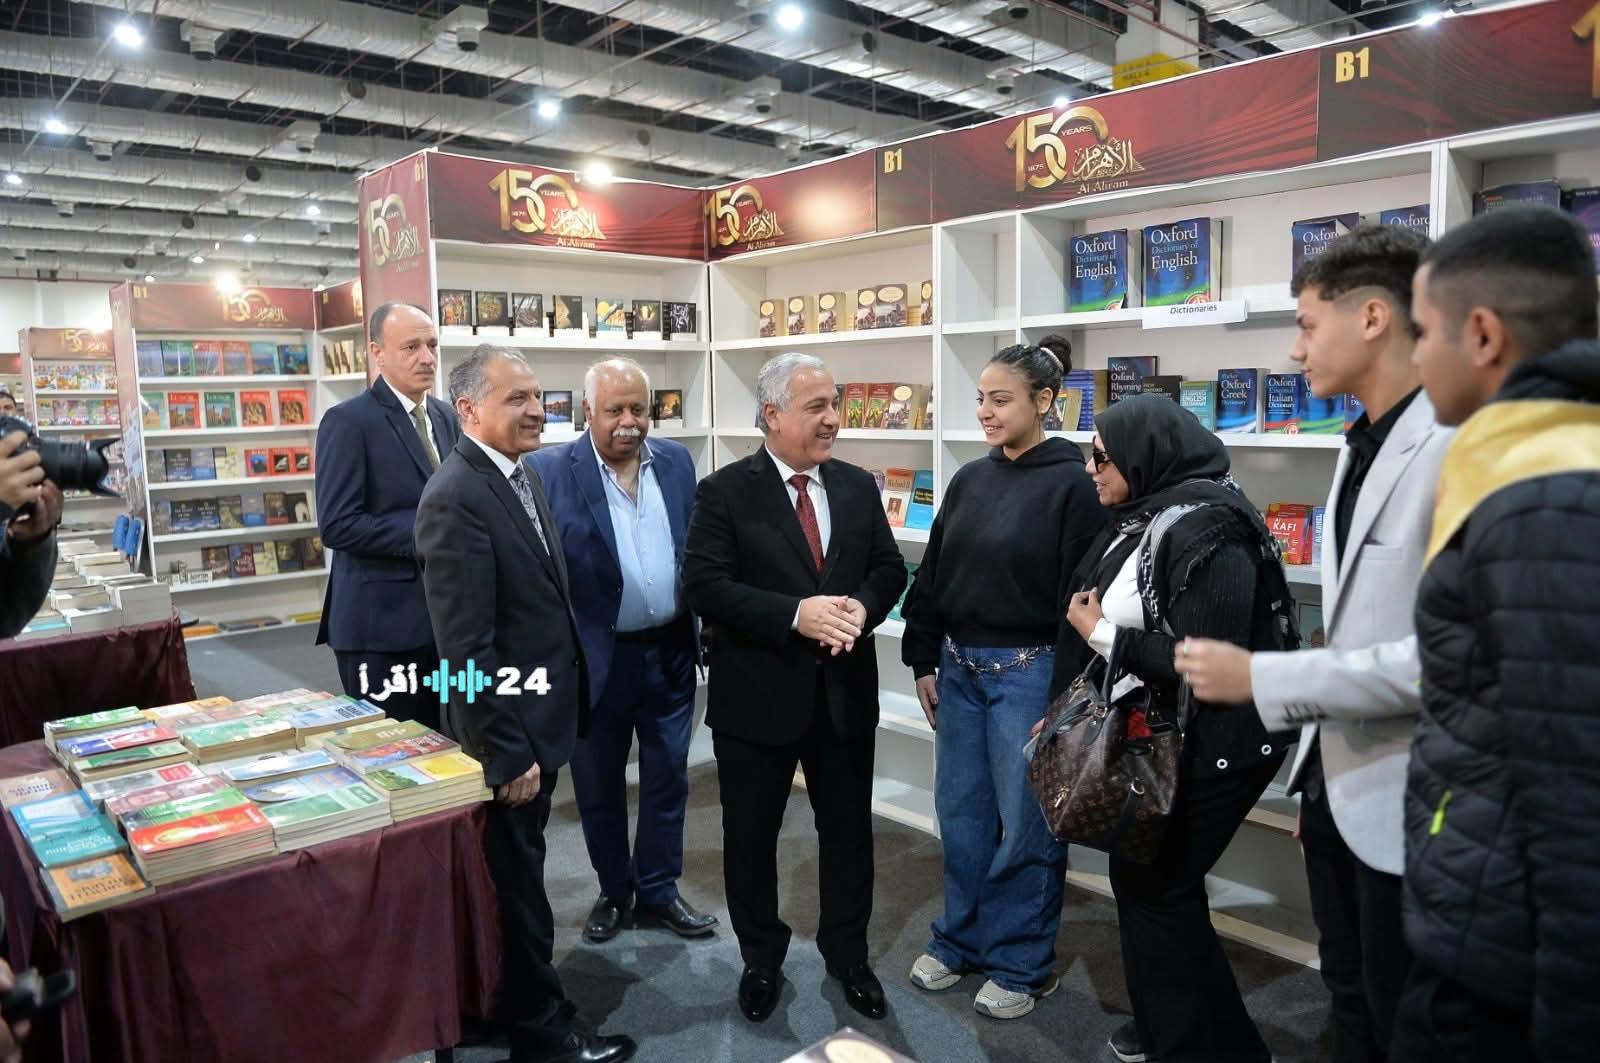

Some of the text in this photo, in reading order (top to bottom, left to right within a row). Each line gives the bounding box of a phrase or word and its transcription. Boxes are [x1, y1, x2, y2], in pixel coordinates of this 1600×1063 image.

[1336, 47, 1370, 83] B1
[1061, 124, 1093, 137] YEARS
[1005, 106, 1109, 191] 150
[884, 147, 902, 174] B1
[488, 168, 577, 233] 150
[705, 184, 763, 248] 150
[1150, 223, 1198, 245] Oxford
[1075, 234, 1116, 254] Oxford
[1151, 241, 1198, 255] Dictionary of
[1076, 252, 1116, 264] Dictionary of
[1151, 251, 1198, 272] English
[1075, 261, 1117, 280] English
[1170, 304, 1217, 315] Dictionaries
[1111, 363, 1128, 372] New
[1111, 373, 1137, 381] Oxford
[1268, 376, 1296, 387] Oxford
[1111, 383, 1142, 393] Rhyming
[1221, 379, 1251, 389] Oxford
[1221, 389, 1248, 399] Greek
[1268, 393, 1293, 402] Italian
[1268, 401, 1296, 410] Dictionary
[1272, 521, 1297, 532] KAFI
